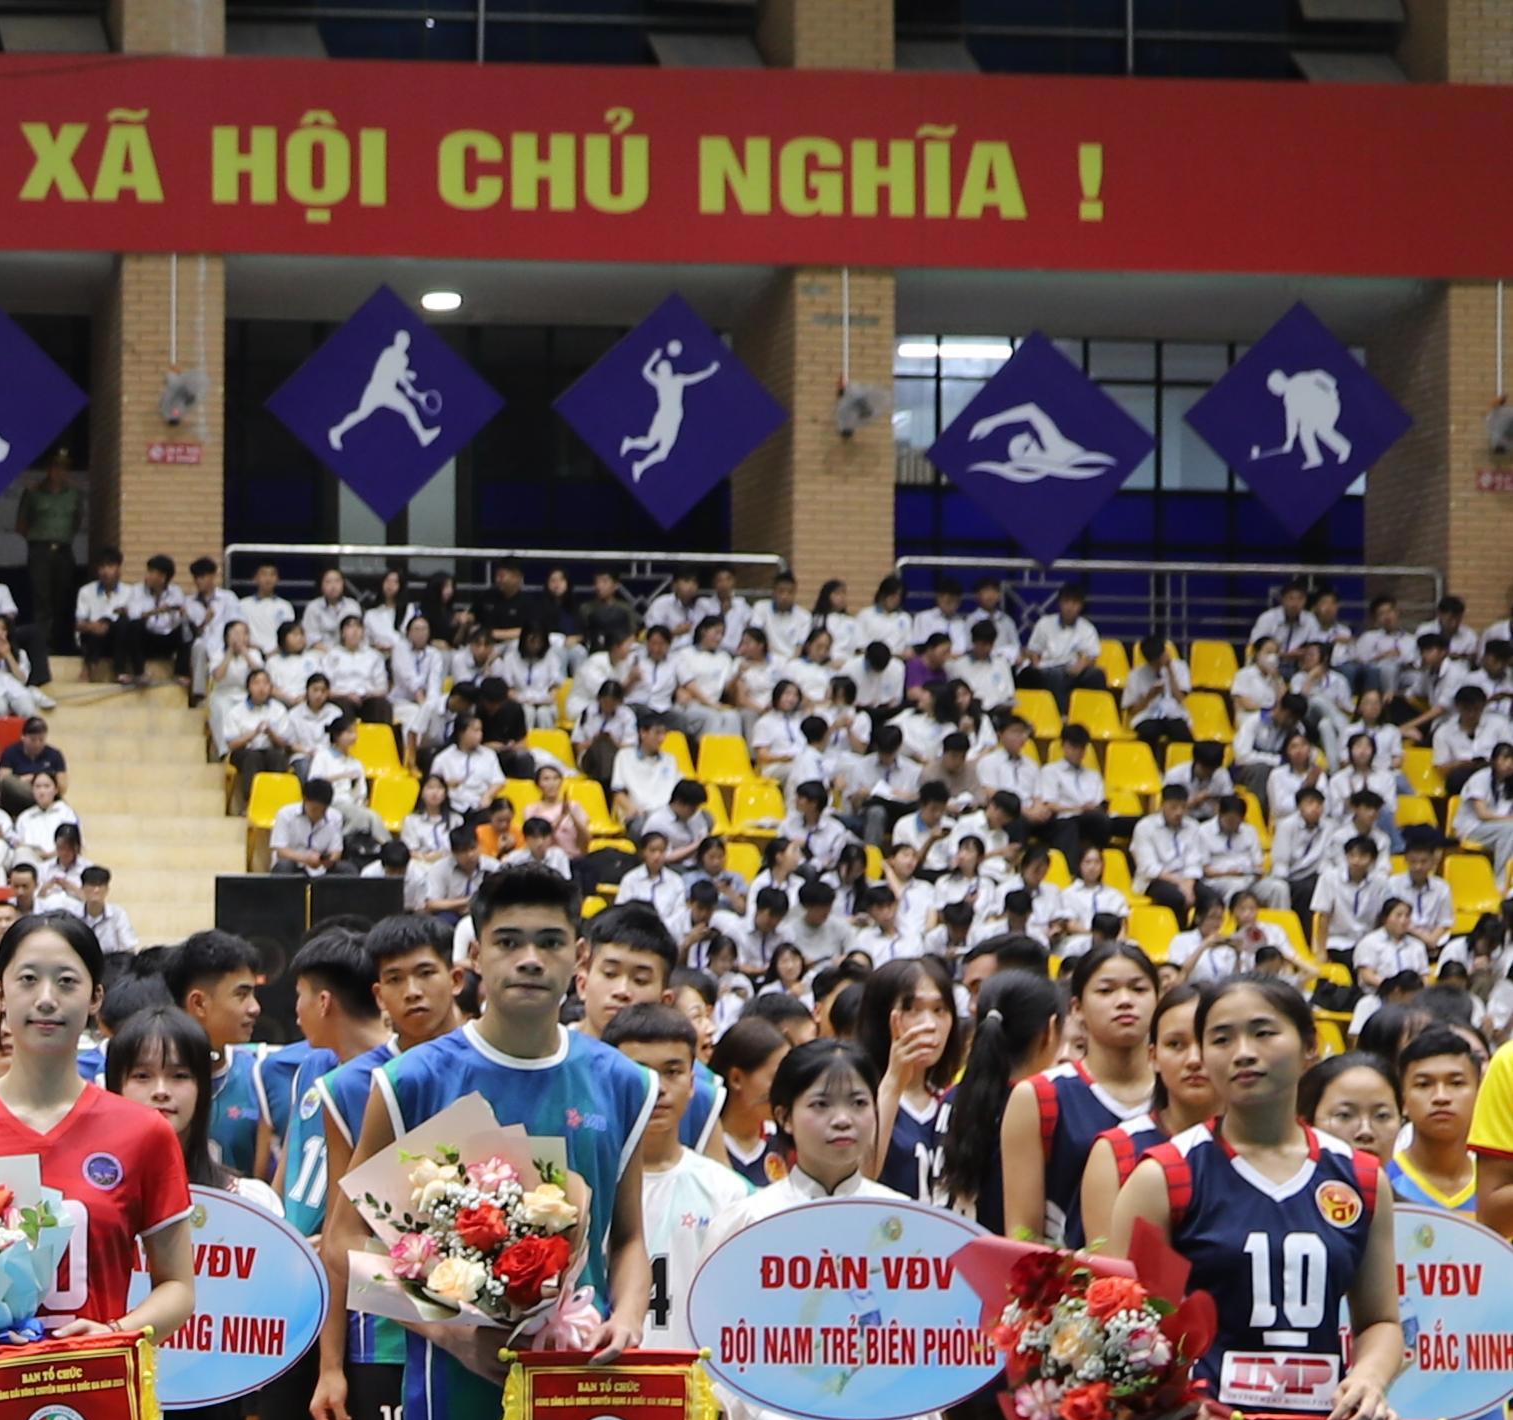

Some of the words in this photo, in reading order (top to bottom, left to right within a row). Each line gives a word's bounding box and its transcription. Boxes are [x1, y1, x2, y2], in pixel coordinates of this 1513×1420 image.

[19, 108, 164, 203] XÃ
[211, 110, 387, 223] HỘI
[438, 107, 649, 214] CHỦ
[698, 123, 1026, 219] NGHĨA
[1078, 143, 1104, 219] !
[191, 1244, 256, 1279] VĐV
[760, 1254, 868, 1290] ĐOÀN
[883, 1256, 955, 1291] VĐV
[1243, 1231, 1329, 1328] 10
[1417, 1264, 1483, 1297] VĐV
[221, 1316, 285, 1356] NINH
[720, 1318, 754, 1370] ĐỘI
[763, 1326, 813, 1366] NAM
[820, 1315, 860, 1366] TRẺ
[865, 1319, 919, 1366] BIÊN
[924, 1319, 996, 1366] PHÒNG
[1419, 1318, 1459, 1371] BẮC
[1230, 1357, 1333, 1395] IMP
